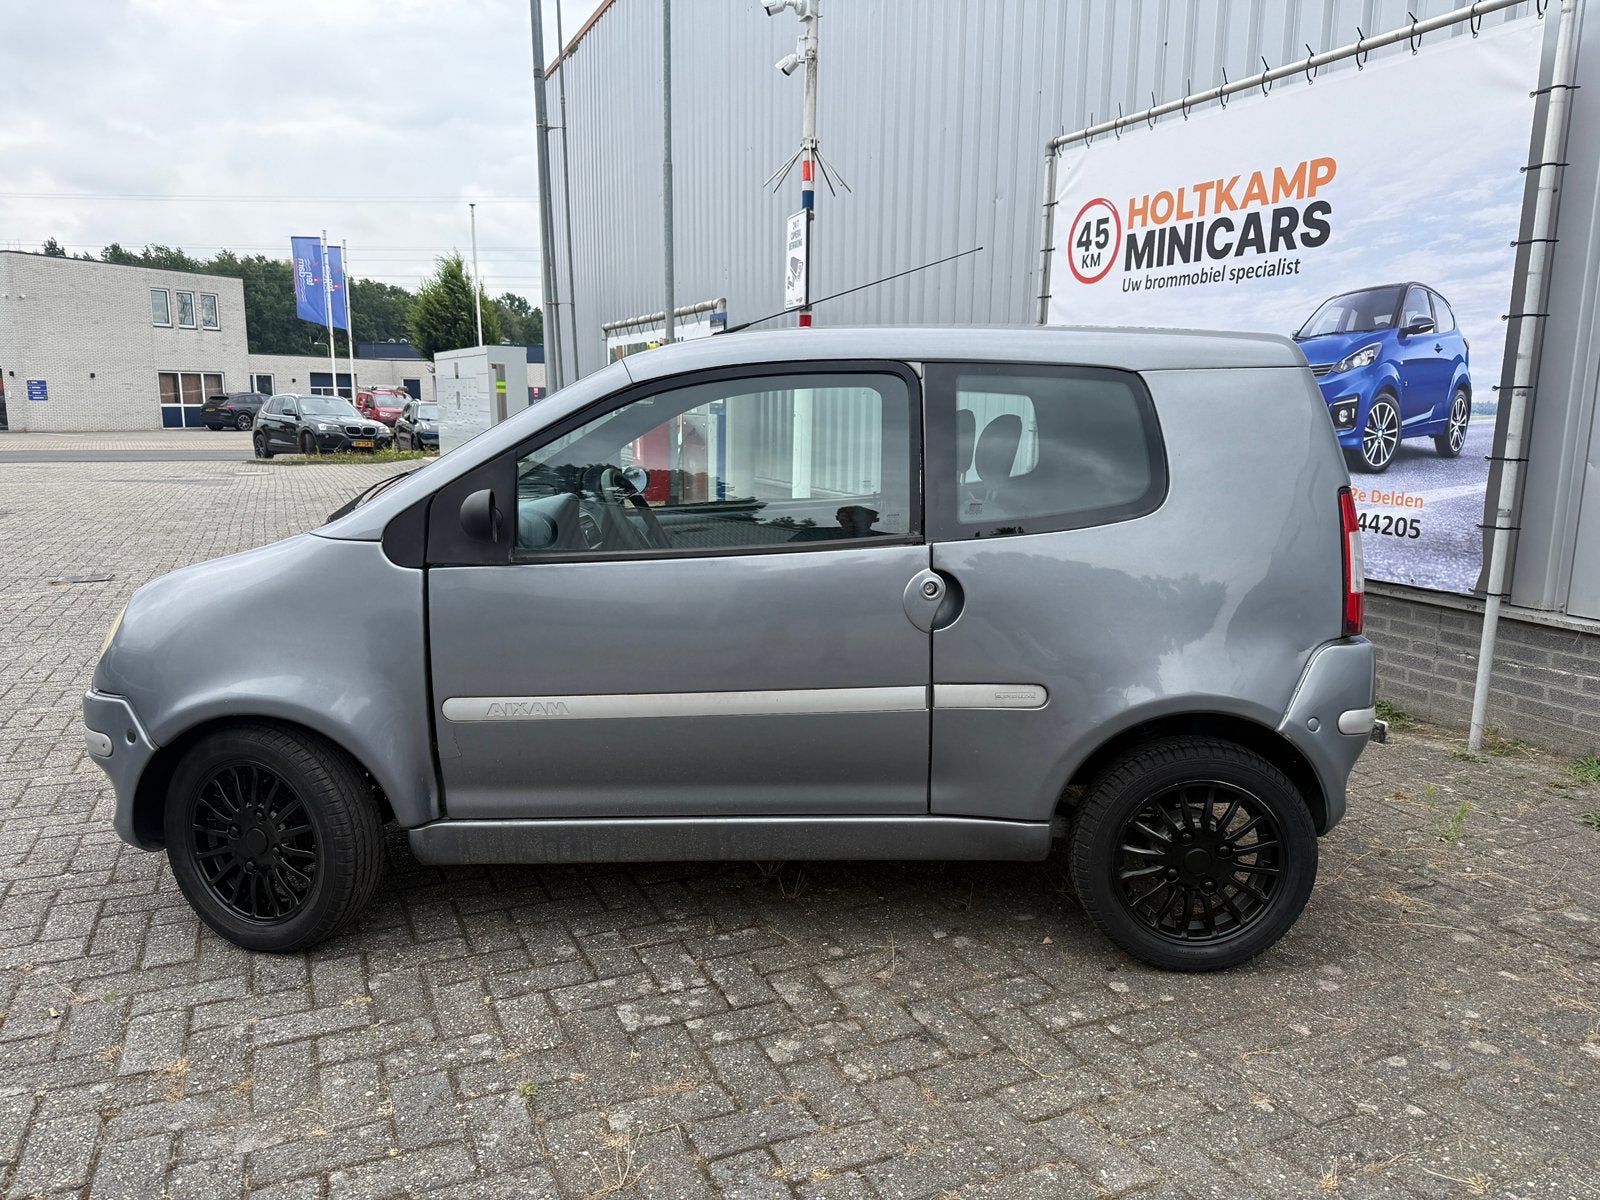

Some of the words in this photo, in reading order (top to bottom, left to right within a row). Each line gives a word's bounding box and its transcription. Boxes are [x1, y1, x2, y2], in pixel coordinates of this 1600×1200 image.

[1127, 156, 1337, 230] HOLTKAMP
[1076, 217, 1110, 252] 45
[1124, 200, 1332, 271] MINICARS
[1081, 252, 1101, 269] KM
[1122, 276, 1142, 293] Uw
[1144, 265, 1227, 290] brommobiel
[1228, 258, 1301, 284] specialist
[1371, 489, 1424, 508] Delden
[1358, 512, 1421, 539] 44205
[486, 702, 570, 717] AIXAM
